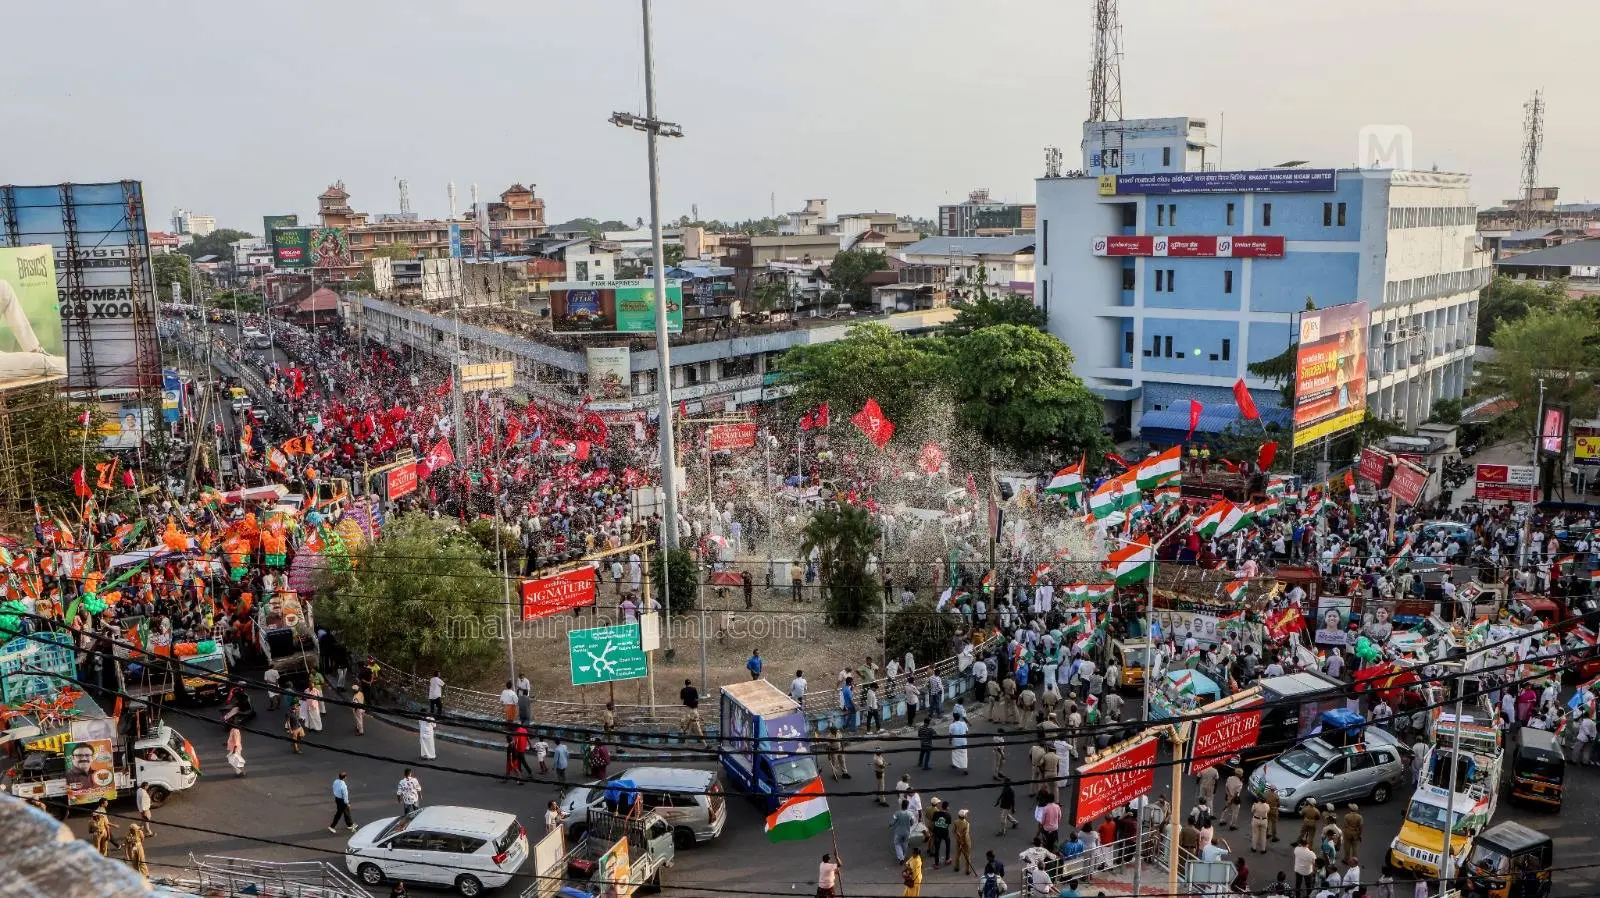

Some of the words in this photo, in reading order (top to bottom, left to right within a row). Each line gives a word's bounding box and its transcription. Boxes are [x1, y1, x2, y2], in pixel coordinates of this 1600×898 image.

[17, 254, 48, 280] BASICS
[92, 302, 133, 319] XOO
[526, 579, 593, 604] SIGNATURE
[1197, 713, 1260, 751] SIGNATURE
[1080, 754, 1155, 803] SIGNATURE
